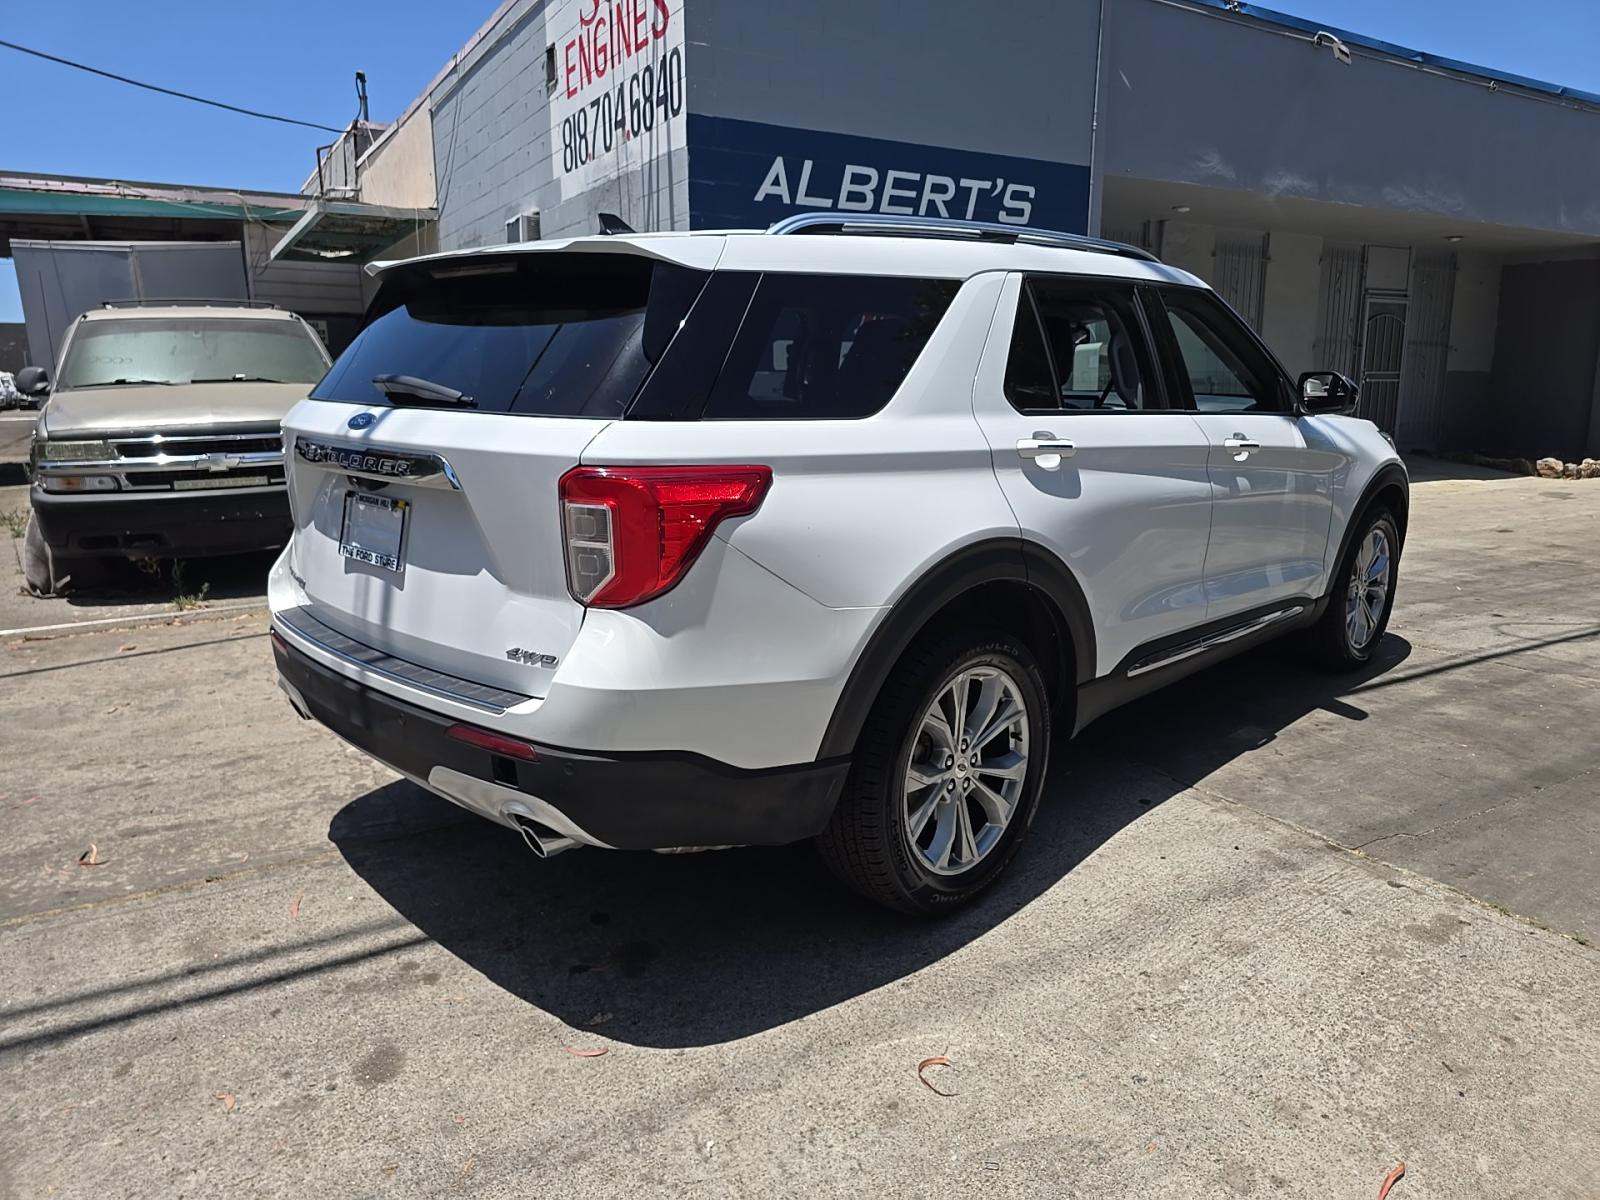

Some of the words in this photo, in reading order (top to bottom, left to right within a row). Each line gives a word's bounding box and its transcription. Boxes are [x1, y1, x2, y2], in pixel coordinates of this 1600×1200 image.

[564, 0, 670, 99] ENGINES
[753, 155, 1037, 226] ALBERT'S
[342, 545, 355, 557] THE
[355, 549, 374, 563] FORD
[374, 554, 397, 570] STORE
